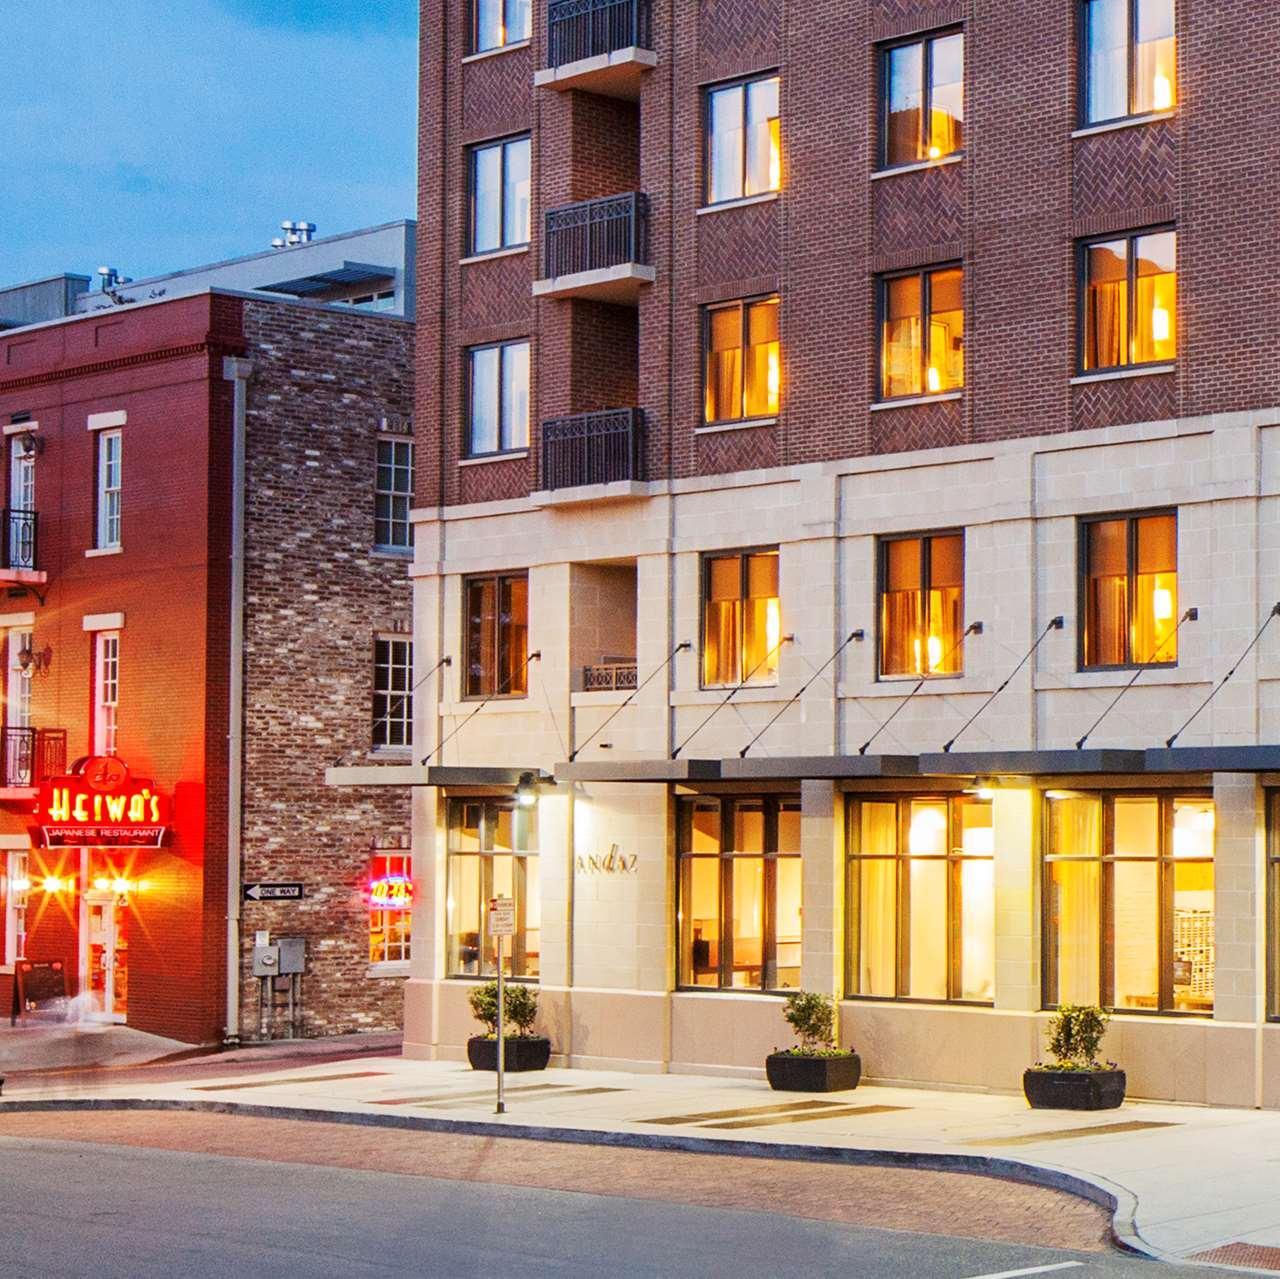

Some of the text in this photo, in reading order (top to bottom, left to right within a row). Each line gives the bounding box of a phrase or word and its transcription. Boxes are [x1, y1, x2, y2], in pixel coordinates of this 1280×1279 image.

[49, 829, 159, 837] JAPANESE RESTAURANT
[280, 888, 297, 896] WAY
